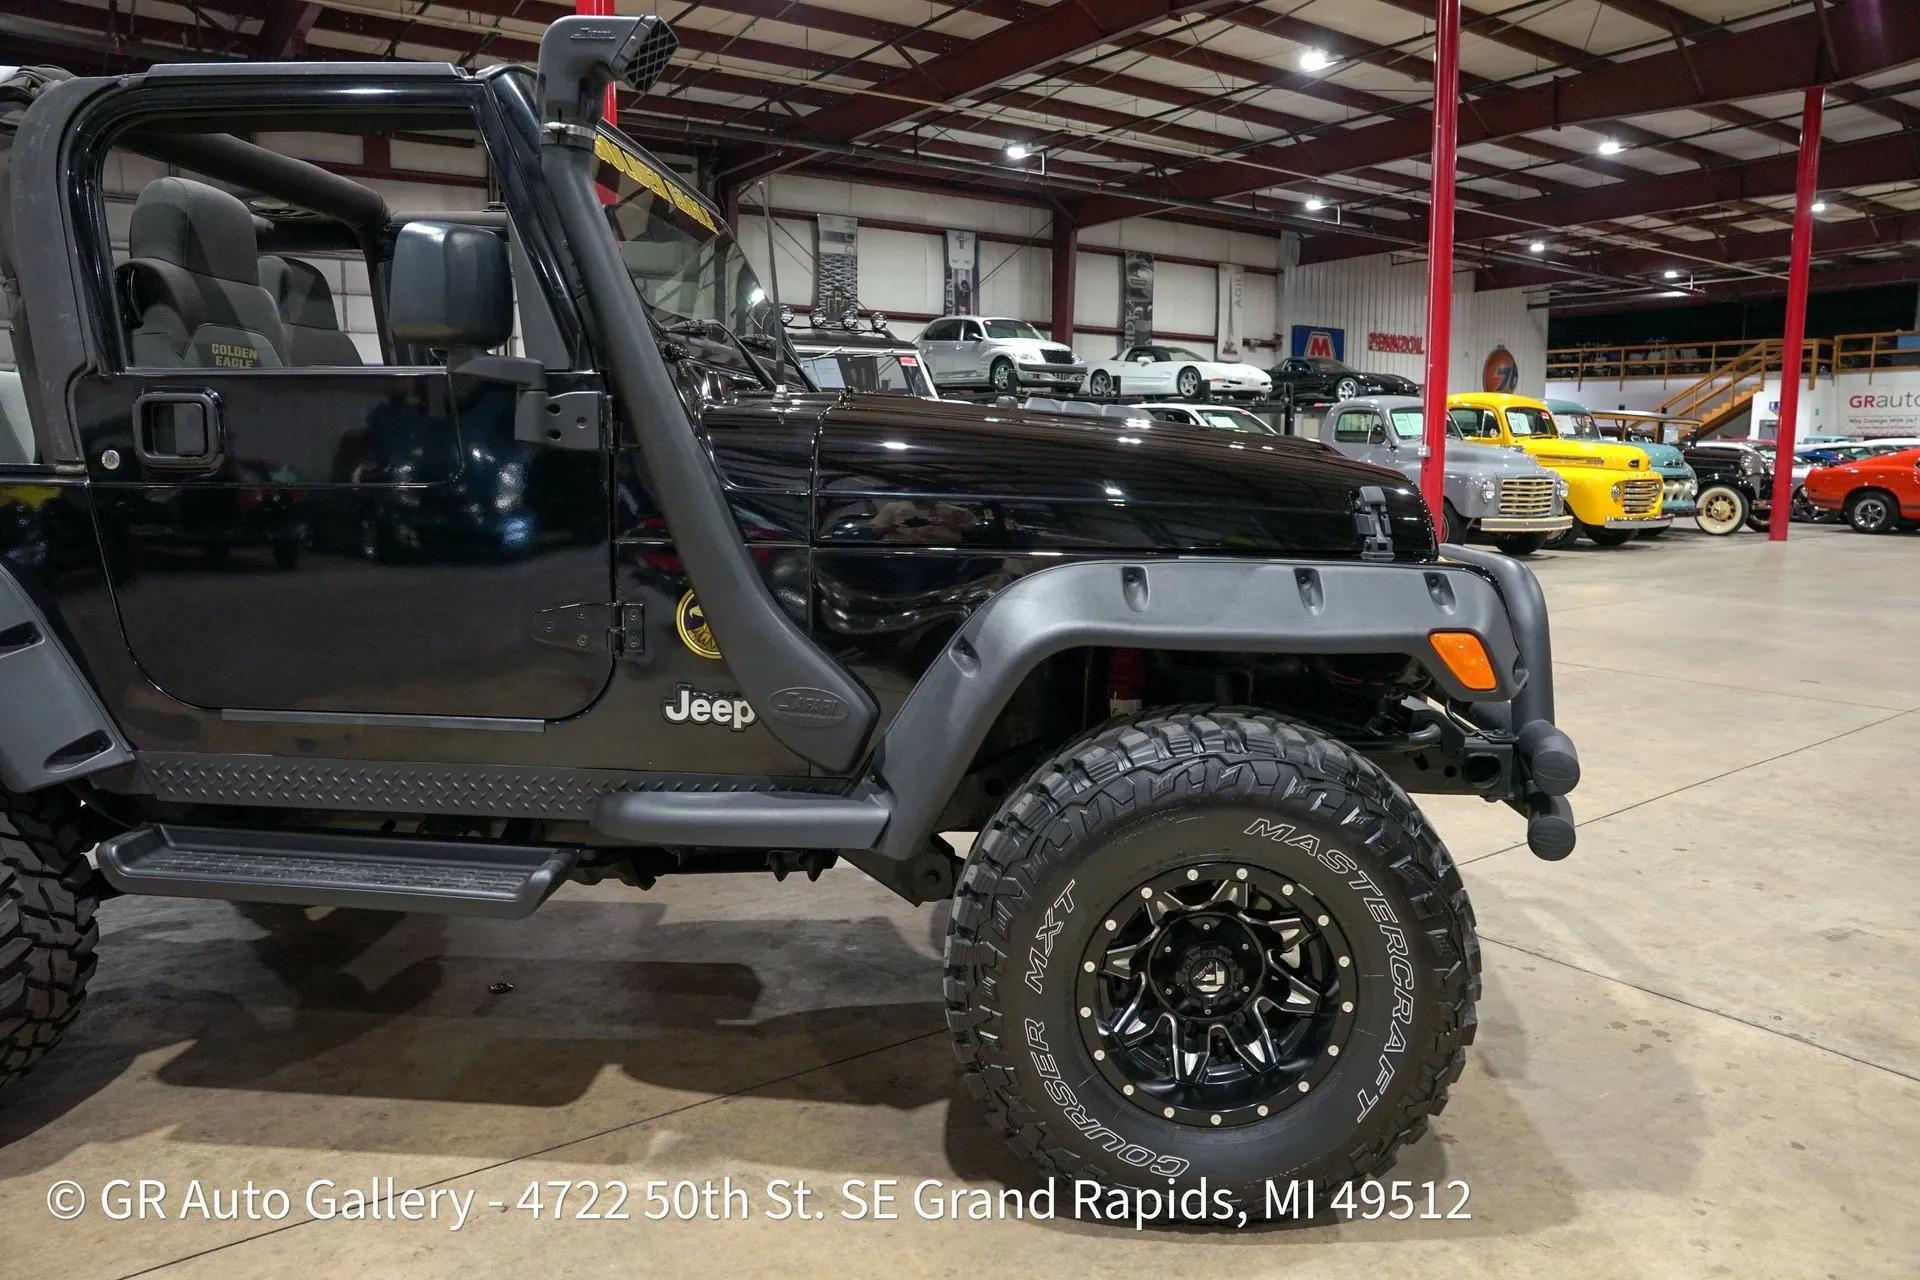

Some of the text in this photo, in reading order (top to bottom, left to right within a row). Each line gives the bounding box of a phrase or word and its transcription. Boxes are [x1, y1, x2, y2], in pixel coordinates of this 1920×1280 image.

[211, 343, 258, 360] GOLDEN
[215, 355, 254, 369] EAGLE
[665, 690, 756, 729] Jeep
[1244, 818, 1415, 1124] MASTERCRAFT
[1024, 878, 1190, 1178] COURSER MXT
